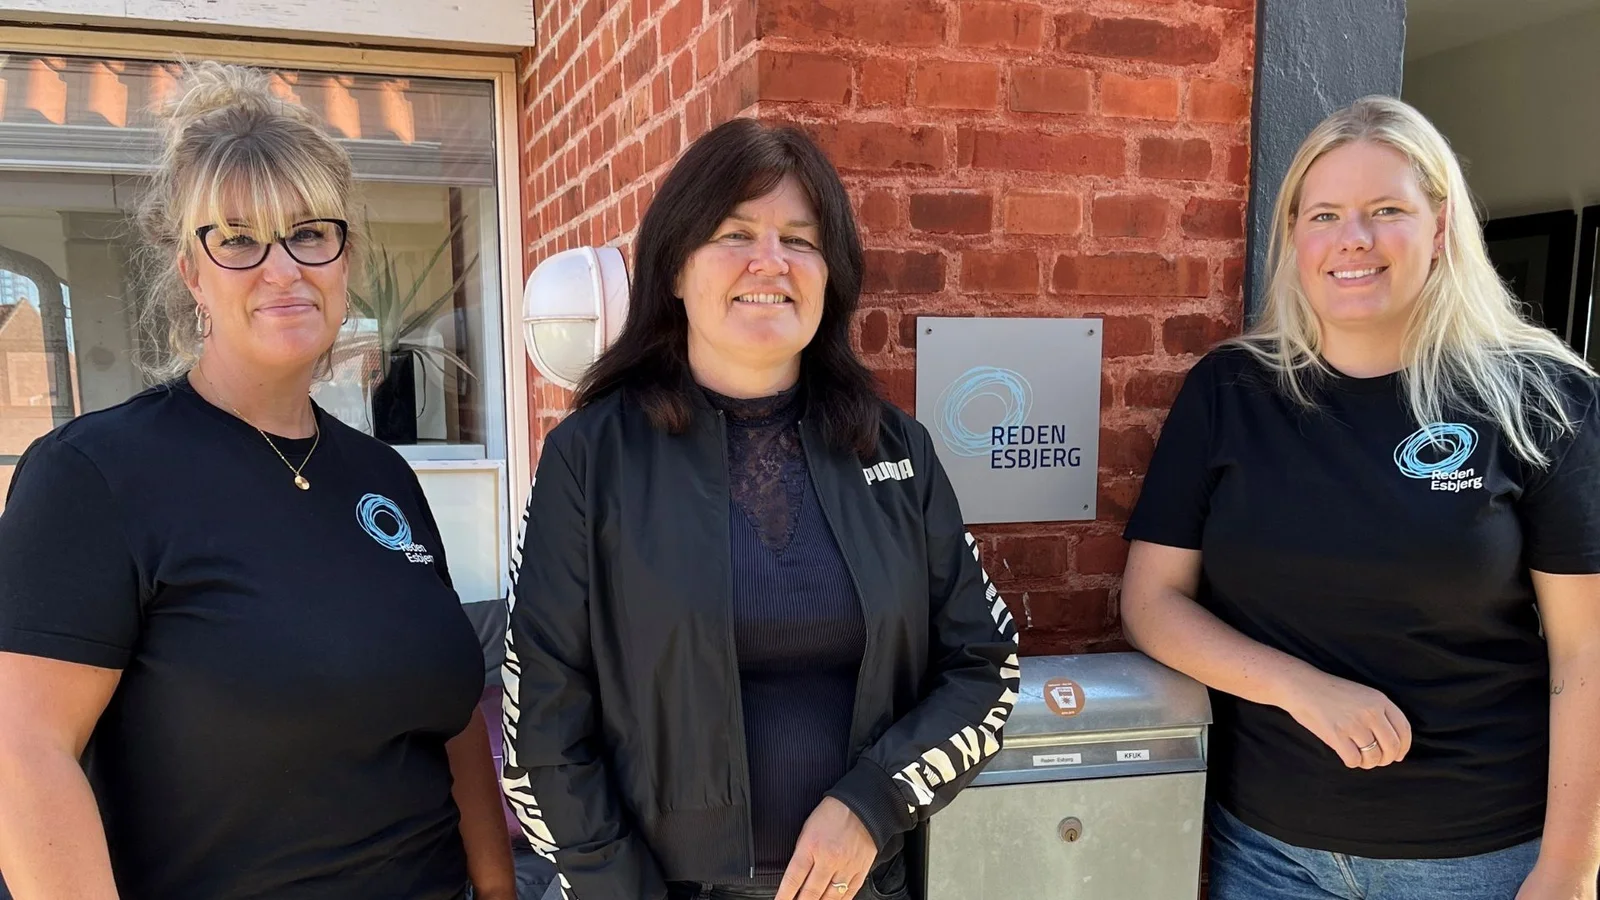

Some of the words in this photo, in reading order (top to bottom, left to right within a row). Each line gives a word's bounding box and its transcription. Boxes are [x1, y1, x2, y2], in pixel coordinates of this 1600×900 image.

[991, 424, 1066, 446] REDEN
[990, 447, 1081, 470] ESBJERG
[862, 458, 915, 486] PUMA
[1431, 467, 1475, 480] Reden
[1430, 476, 1483, 493] Esbjerg
